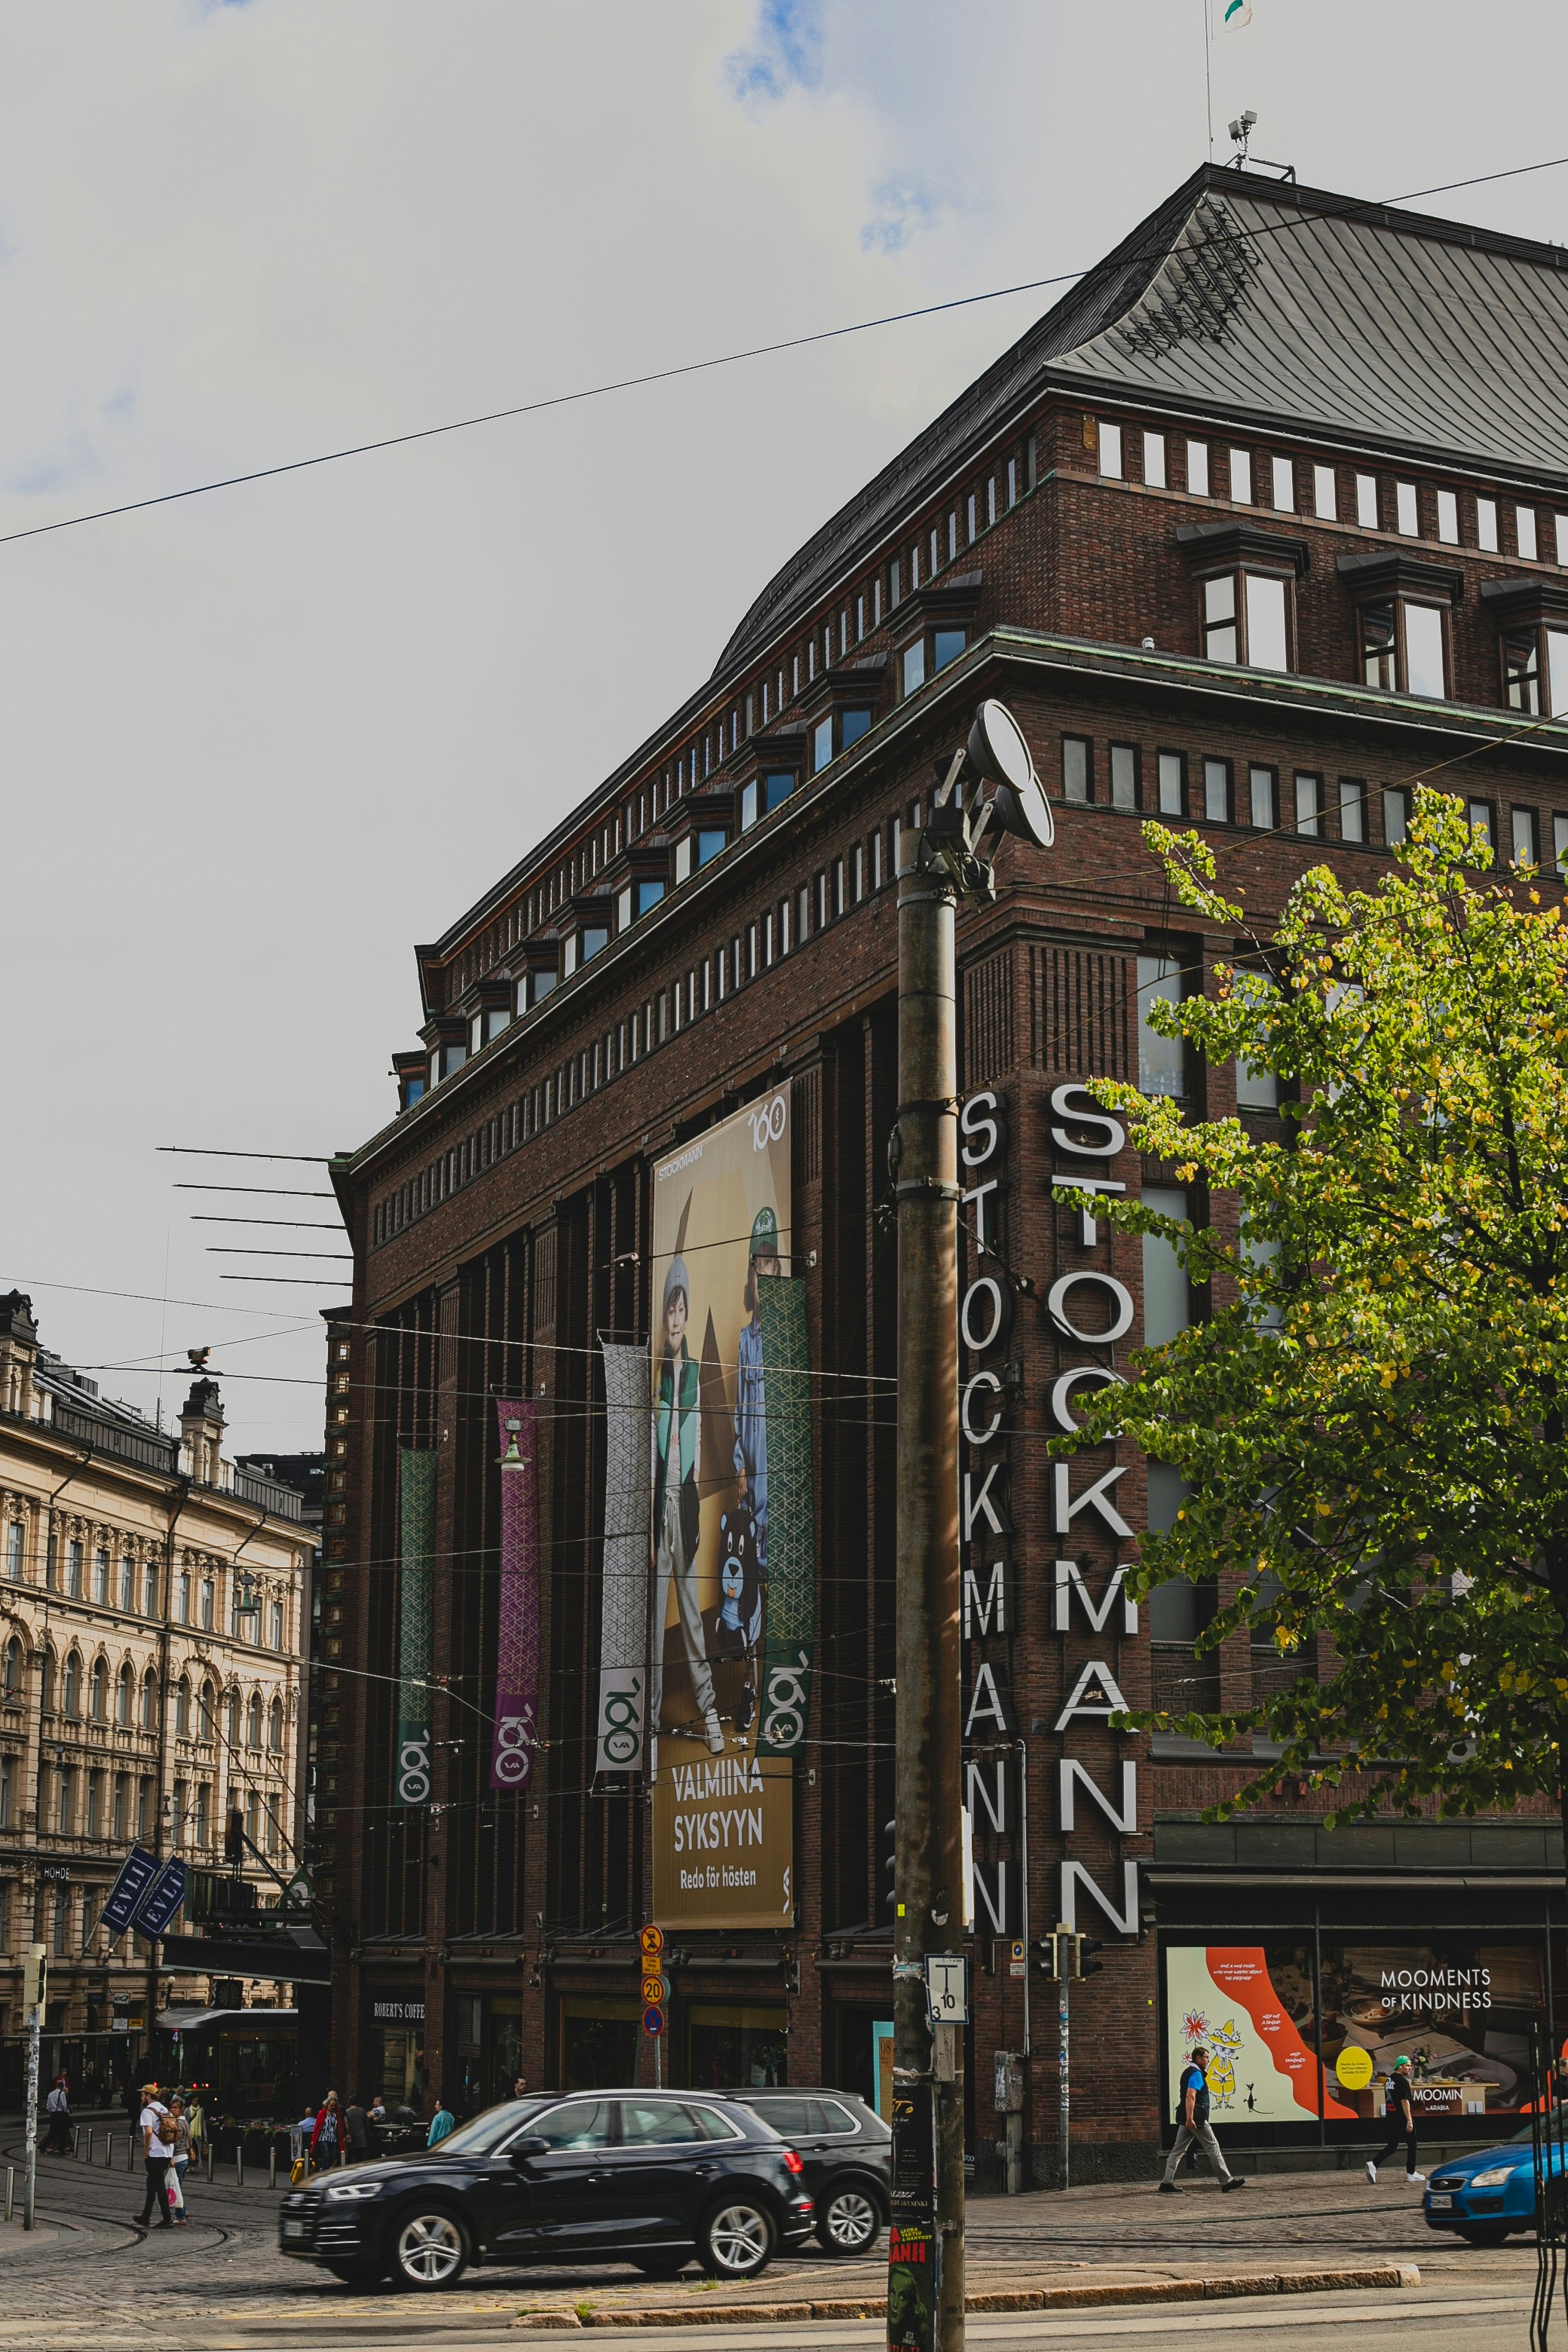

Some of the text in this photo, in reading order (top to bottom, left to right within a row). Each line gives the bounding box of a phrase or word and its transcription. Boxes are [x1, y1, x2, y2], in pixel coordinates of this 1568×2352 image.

[747, 1095, 786, 1153] 160
[658, 1144, 703, 1182] STOCKMANN
[961, 1092, 1006, 1934] STOCKMANN
[1049, 1084, 1139, 1934] STOCKMANN
[672, 1757, 764, 1802] VALMIINA
[674, 1807, 762, 1852] SYKSYYN
[44, 1867, 70, 1879] HOHDE
[680, 1864, 756, 1889] Redo för hösten
[112, 1866, 145, 1916] EVLI
[146, 1876, 182, 1924] EVLI
[1381, 1968, 1491, 1987] MOOMENTS
[645, 1983, 660, 1998] 20
[940, 1994, 956, 2009] 10
[1381, 1992, 1492, 2011] OF KINDNESS
[374, 2002, 403, 2018] ROBERT'S
[932, 2005, 942, 2020] 3
[1413, 2089, 1462, 2101] MOOMIN
